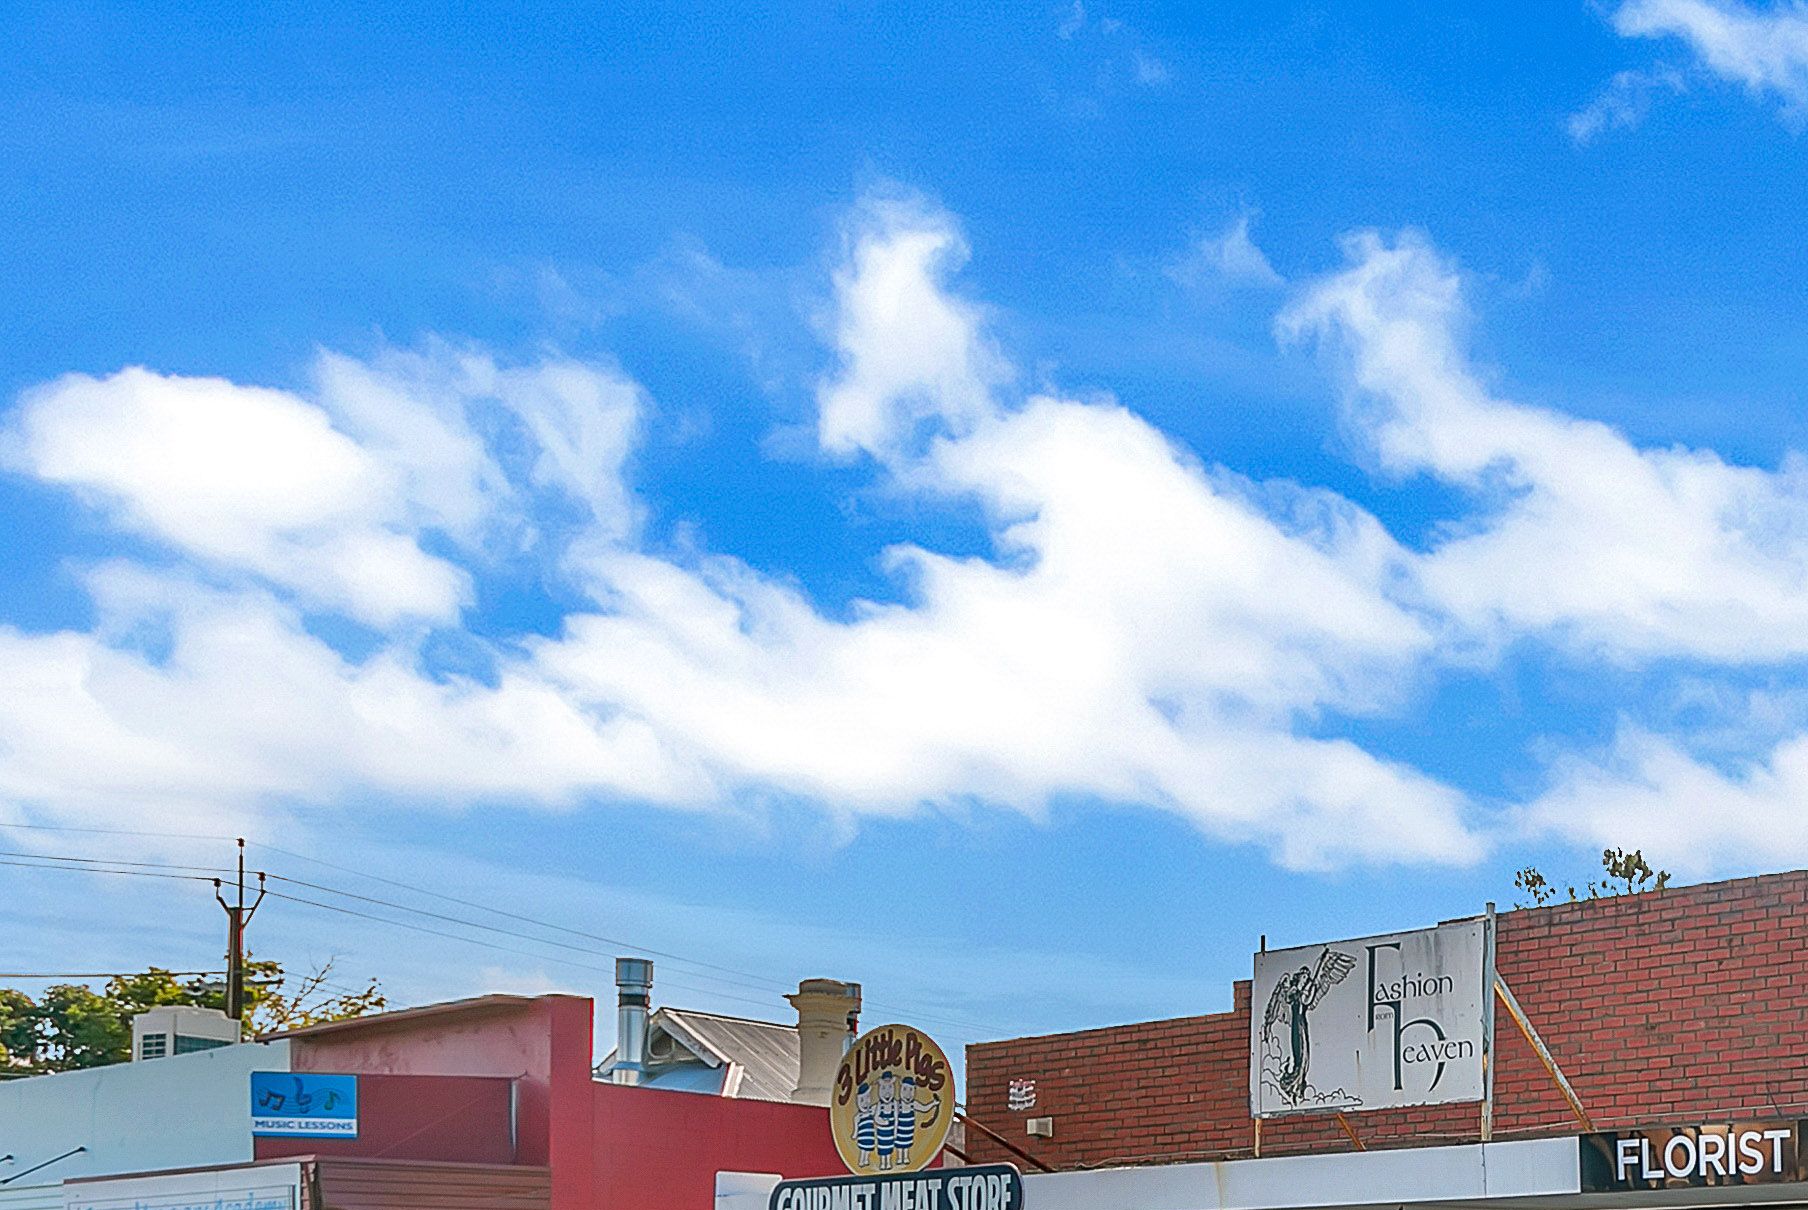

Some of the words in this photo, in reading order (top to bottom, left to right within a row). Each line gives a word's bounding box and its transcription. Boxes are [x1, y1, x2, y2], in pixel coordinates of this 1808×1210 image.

[838, 1063, 853, 1105] 3
[855, 1029, 903, 1084] Little
[905, 1032, 946, 1091] Pigs
[255, 1120, 295, 1129] MUSIC
[298, 1121, 354, 1131] LESSONS
[1616, 1130, 1791, 1180] FLORIST
